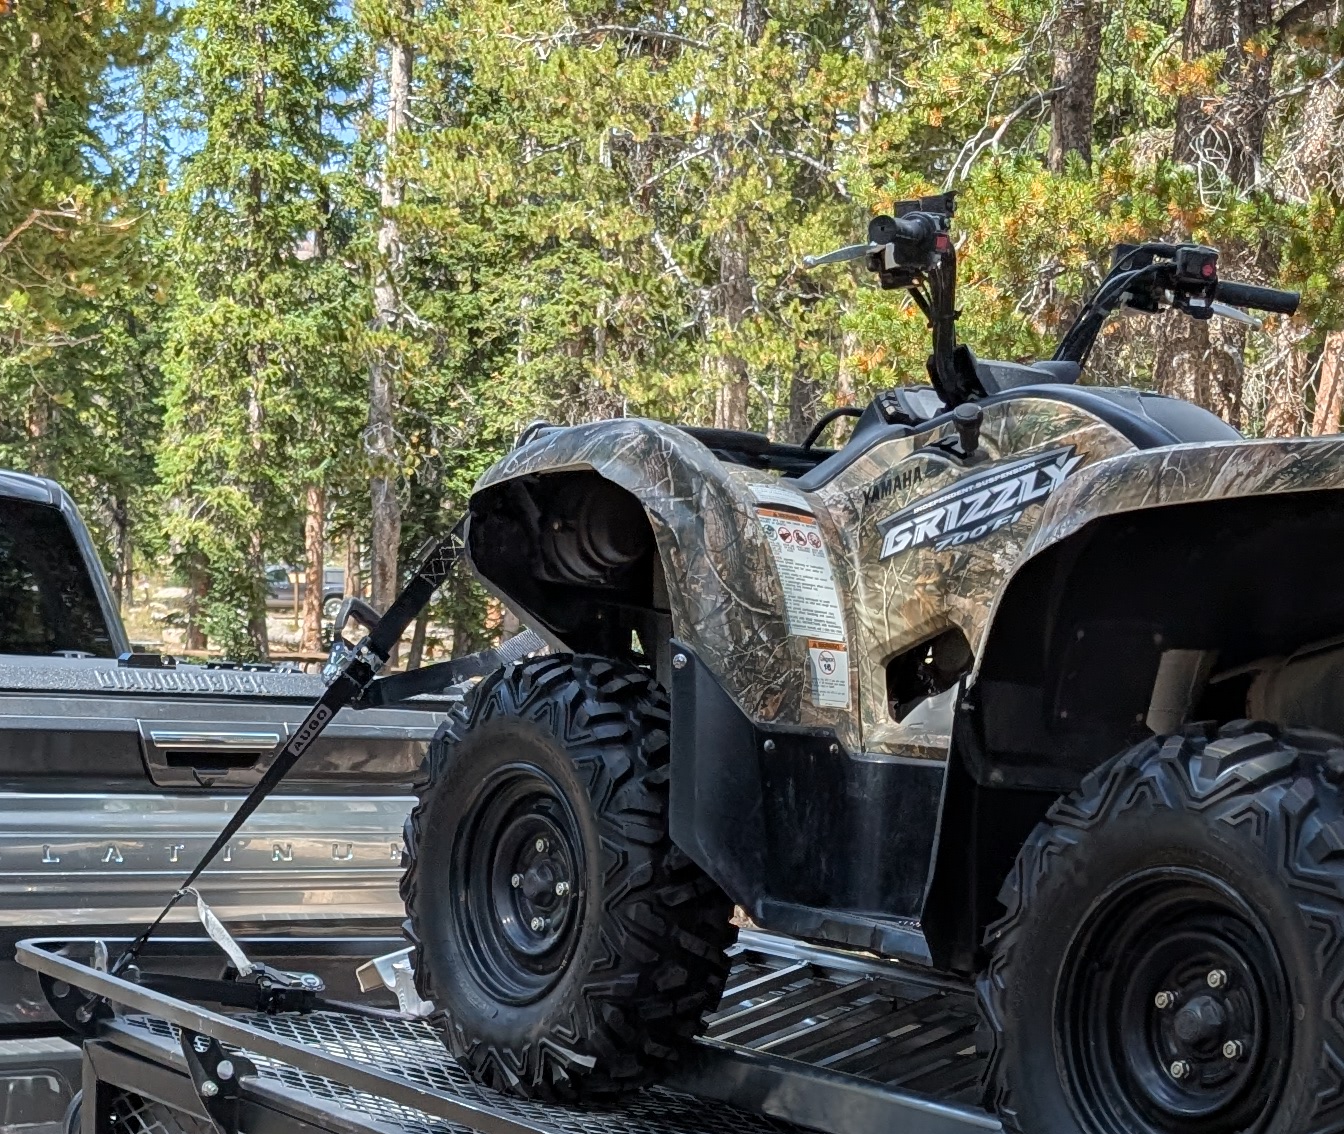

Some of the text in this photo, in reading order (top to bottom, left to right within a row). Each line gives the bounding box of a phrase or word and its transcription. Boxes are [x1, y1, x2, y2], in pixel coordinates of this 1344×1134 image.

[862, 466, 923, 505] YAMAHA
[975, 461, 1036, 489] SUSPENSION
[879, 454, 1085, 560] GRIZZLY
[935, 525, 988, 552] 700
[293, 709, 328, 752] AUGO
